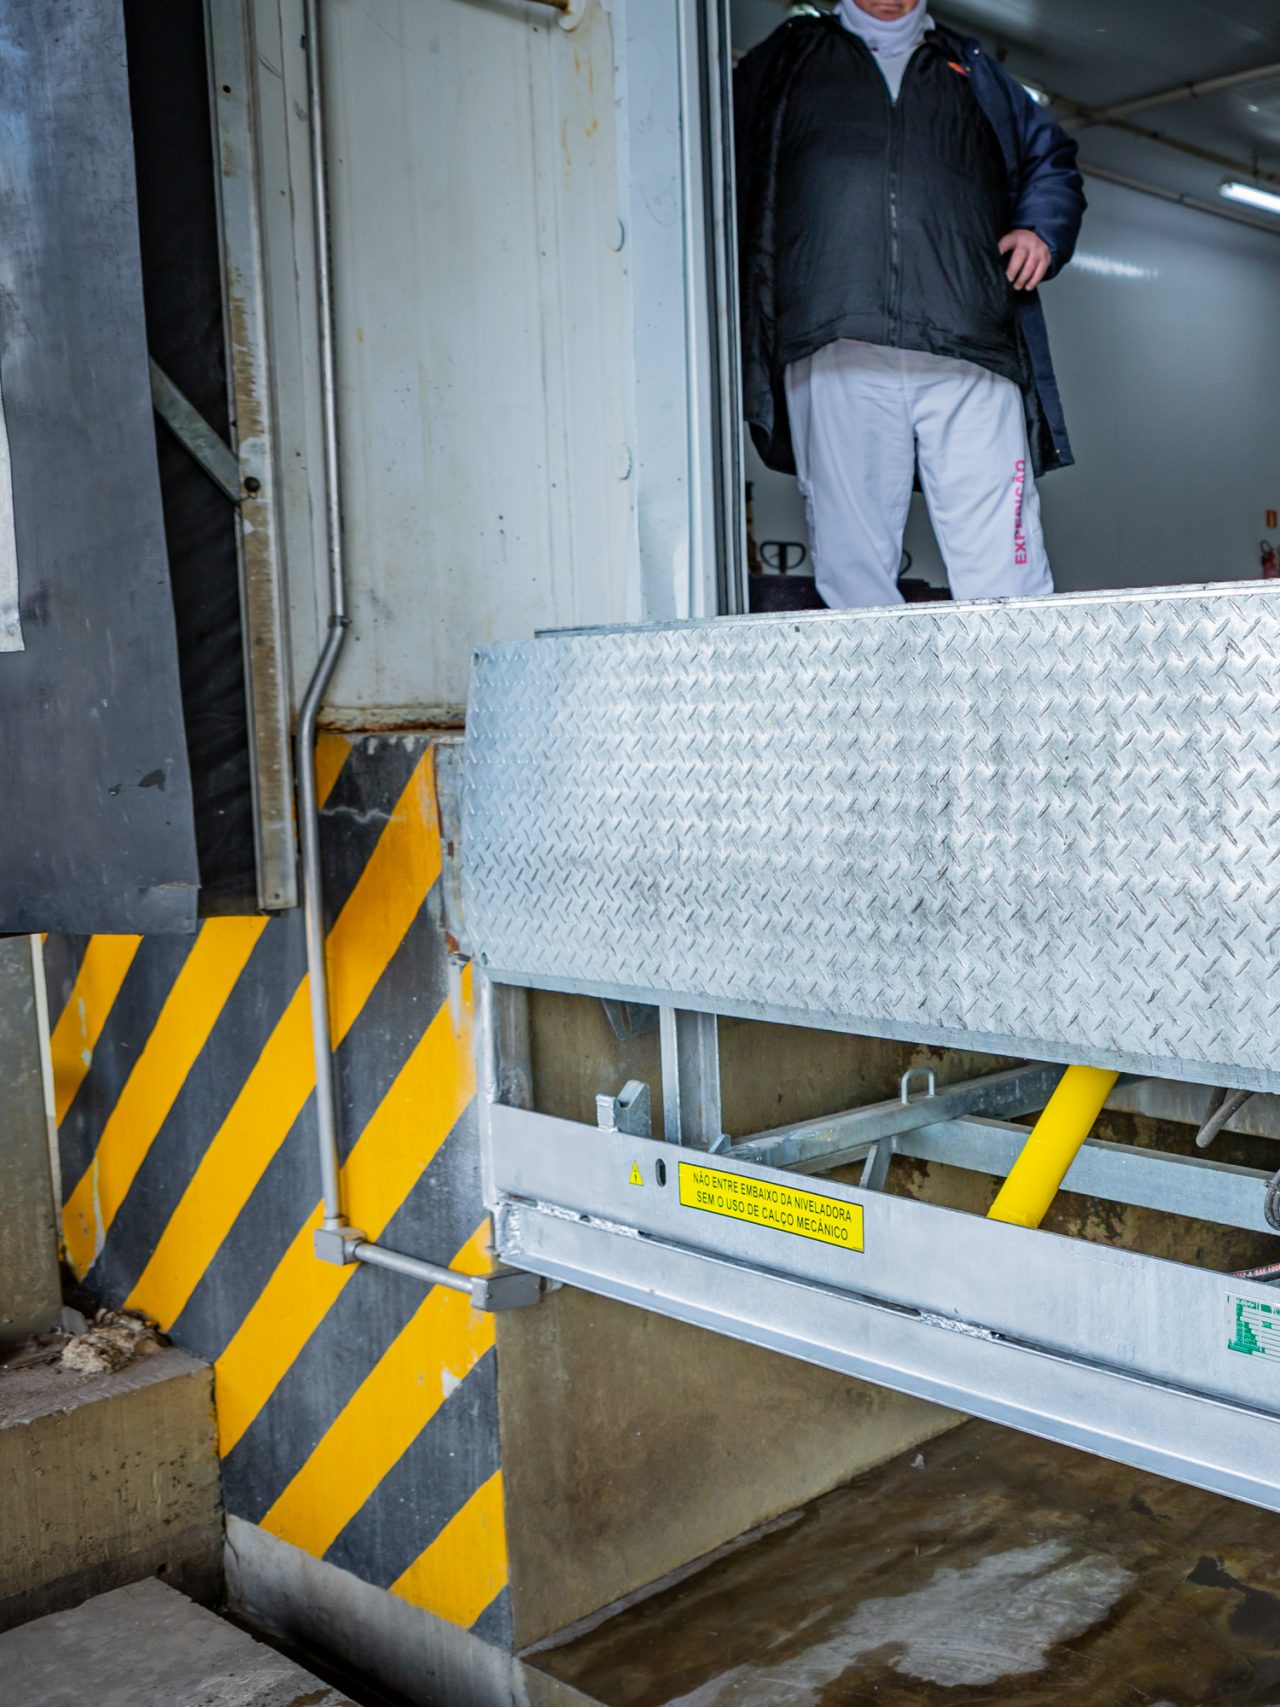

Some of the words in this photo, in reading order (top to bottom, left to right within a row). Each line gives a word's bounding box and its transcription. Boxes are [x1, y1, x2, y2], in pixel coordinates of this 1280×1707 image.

[693, 1171, 711, 1187] NÃO
[712, 1176, 739, 1194] ENTRE
[740, 1183, 779, 1204] EMBAIXO
[780, 1193, 793, 1207] DA
[794, 1196, 852, 1223] NIVELADORA
[696, 1190, 715, 1206] SEM
[717, 1195, 724, 1208] O
[726, 1198, 745, 1213] USO
[747, 1203, 760, 1217] DE
[761, 1207, 795, 1228] CALÇO
[796, 1216, 849, 1241] MECÂNICO
